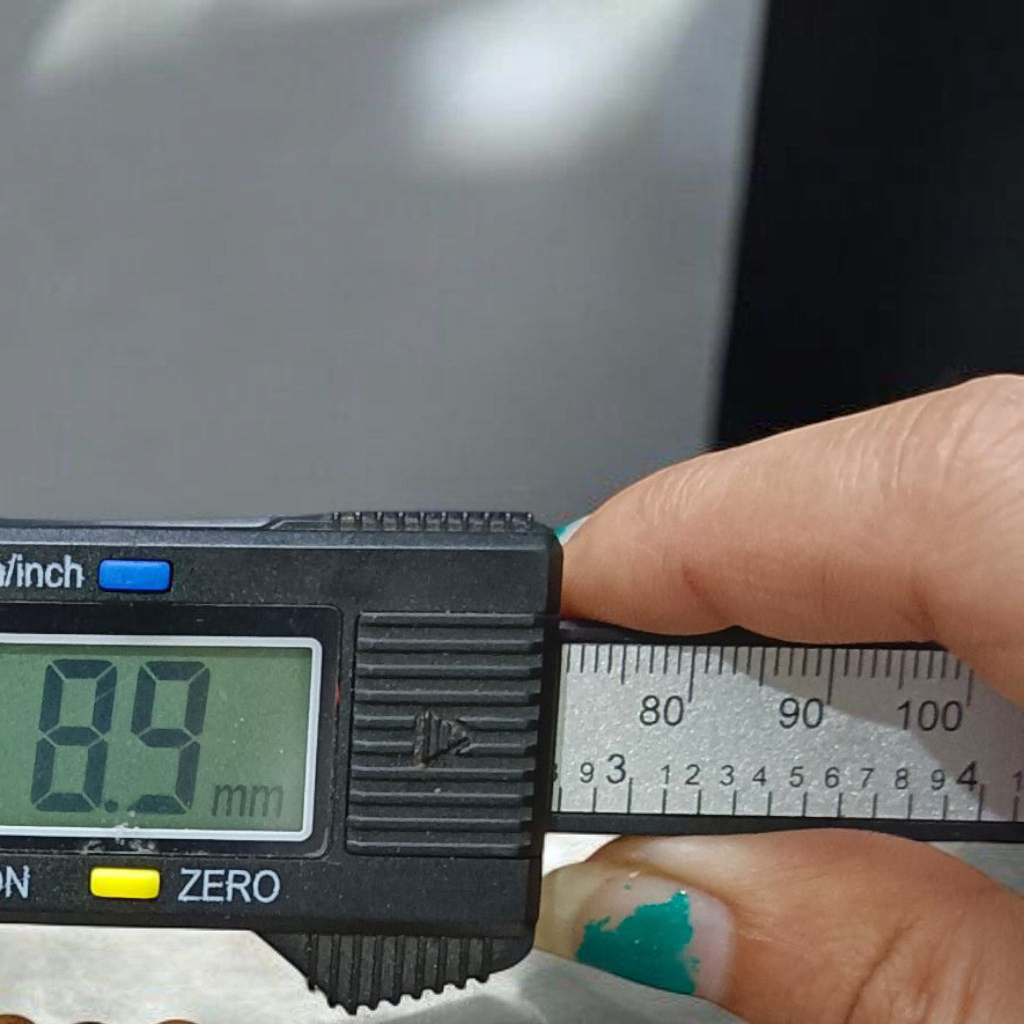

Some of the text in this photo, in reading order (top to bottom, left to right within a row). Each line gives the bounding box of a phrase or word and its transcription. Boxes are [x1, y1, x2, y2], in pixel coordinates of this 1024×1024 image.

[639, 695, 963, 732] 80 90 100
[30, 658, 284, 818] 8.9 mm
[580, 762, 595, 783] 9
[606, 753, 626, 784] 3
[661, 764, 671, 785] 1
[685, 764, 701, 785] 2
[720, 765, 735, 786] 3
[752, 766, 768, 787] 4
[789, 766, 804, 788] 5
[825, 767, 840, 788] 6
[860, 768, 874, 788] 7
[895, 768, 910, 790] 8
[931, 769, 946, 790] 9
[956, 761, 978, 792] 4
[177, 867, 281, 903] ZERO
